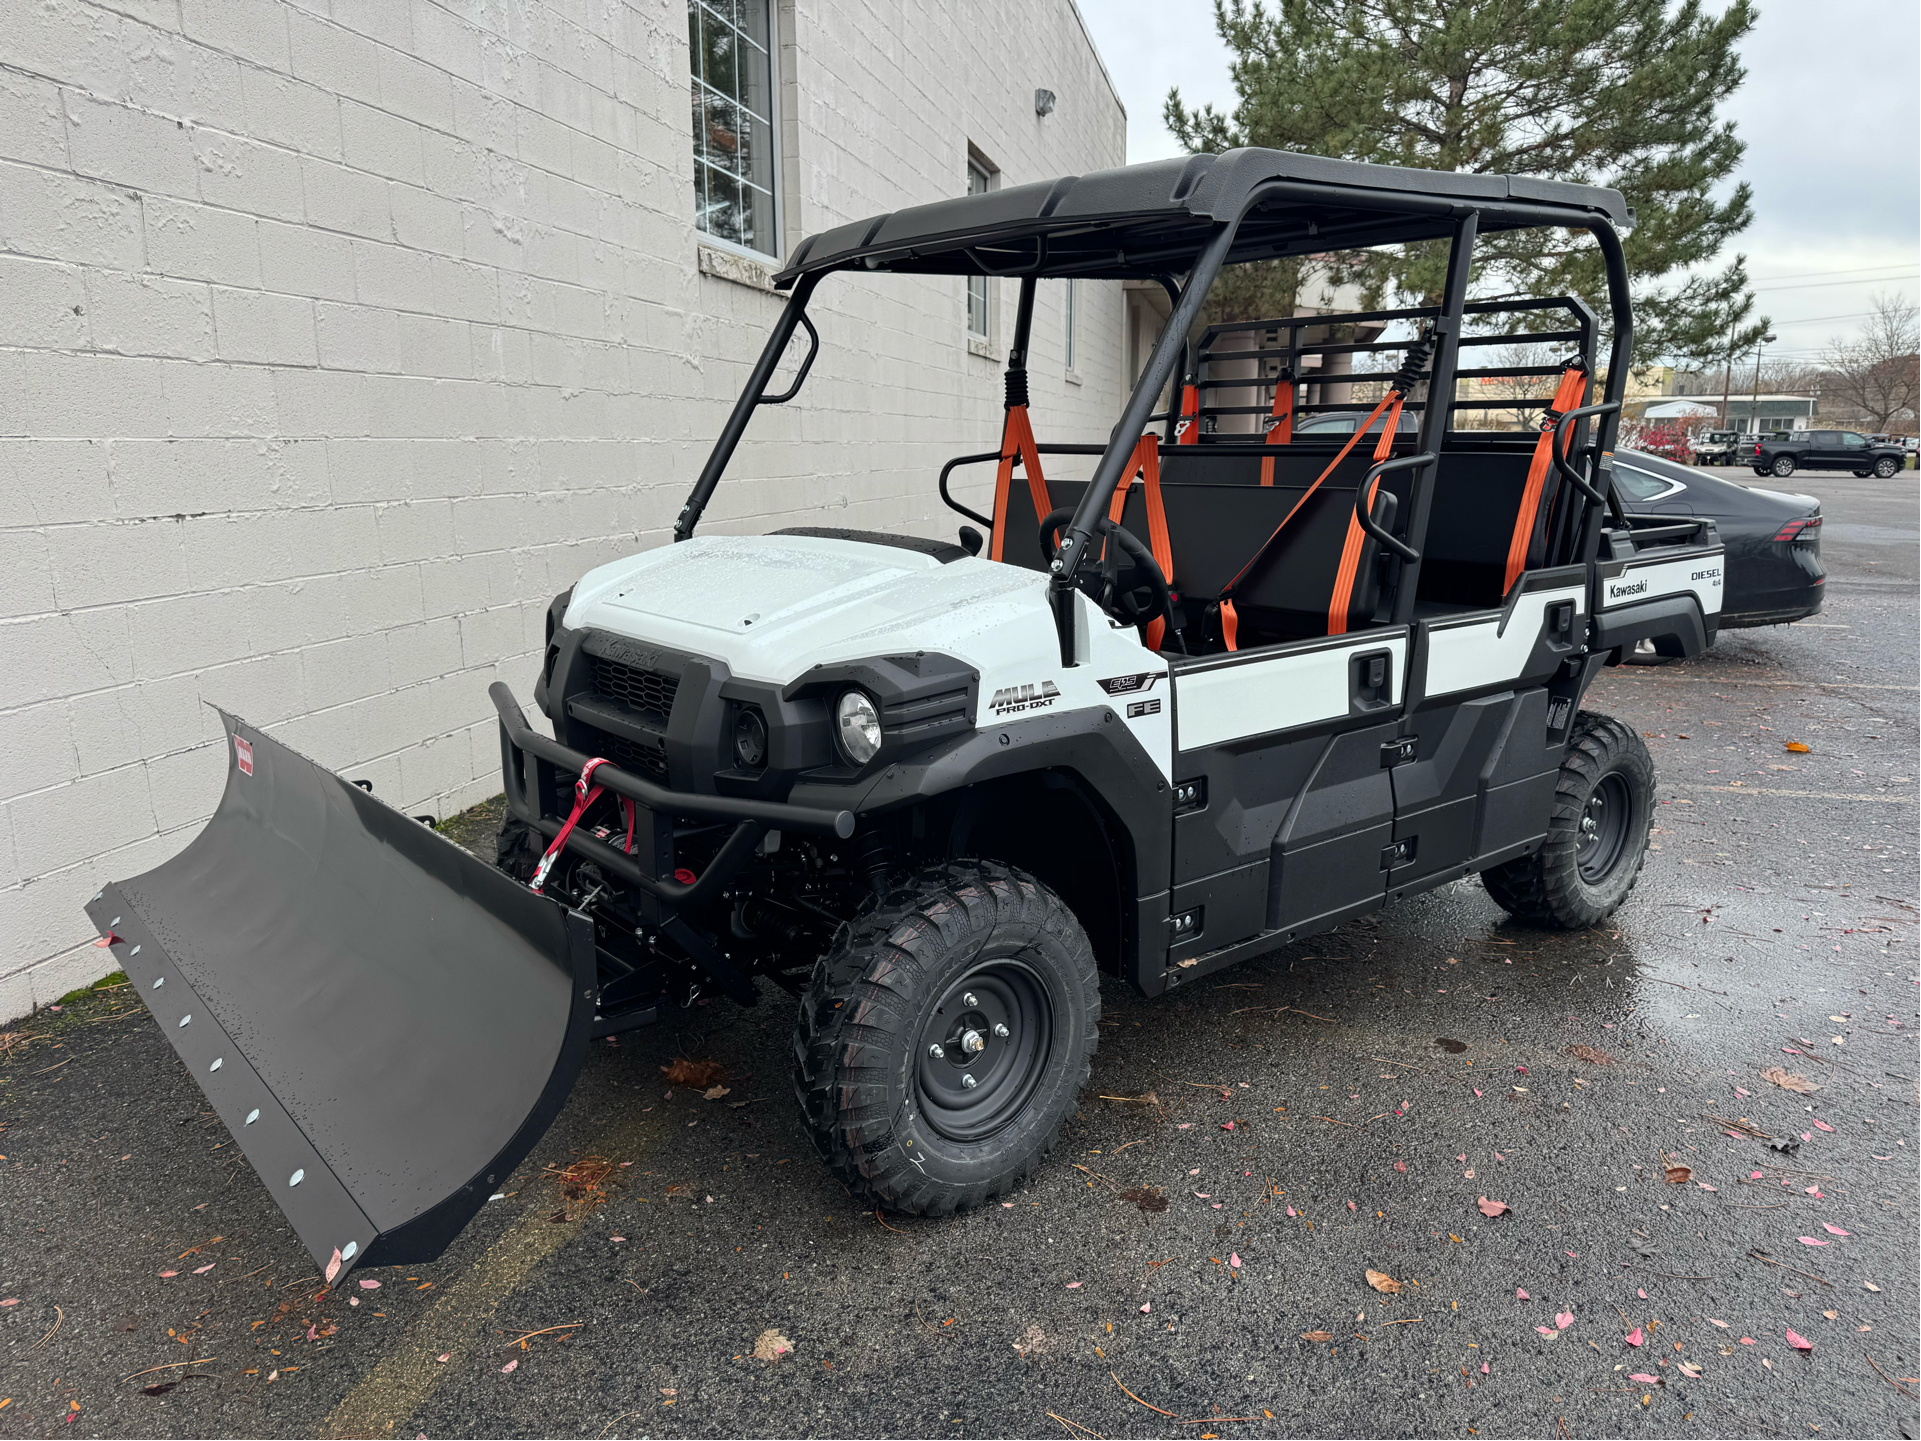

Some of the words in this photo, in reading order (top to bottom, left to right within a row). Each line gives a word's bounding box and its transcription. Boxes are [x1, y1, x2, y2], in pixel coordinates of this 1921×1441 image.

[1691, 568, 1722, 581] DIESEL
[1610, 579, 1648, 599] Kawasaki
[1109, 675, 1137, 690] EPS
[988, 680, 1061, 709] MULE
[996, 698, 1055, 716] PRO-DXT
[1128, 700, 1160, 717] FE
